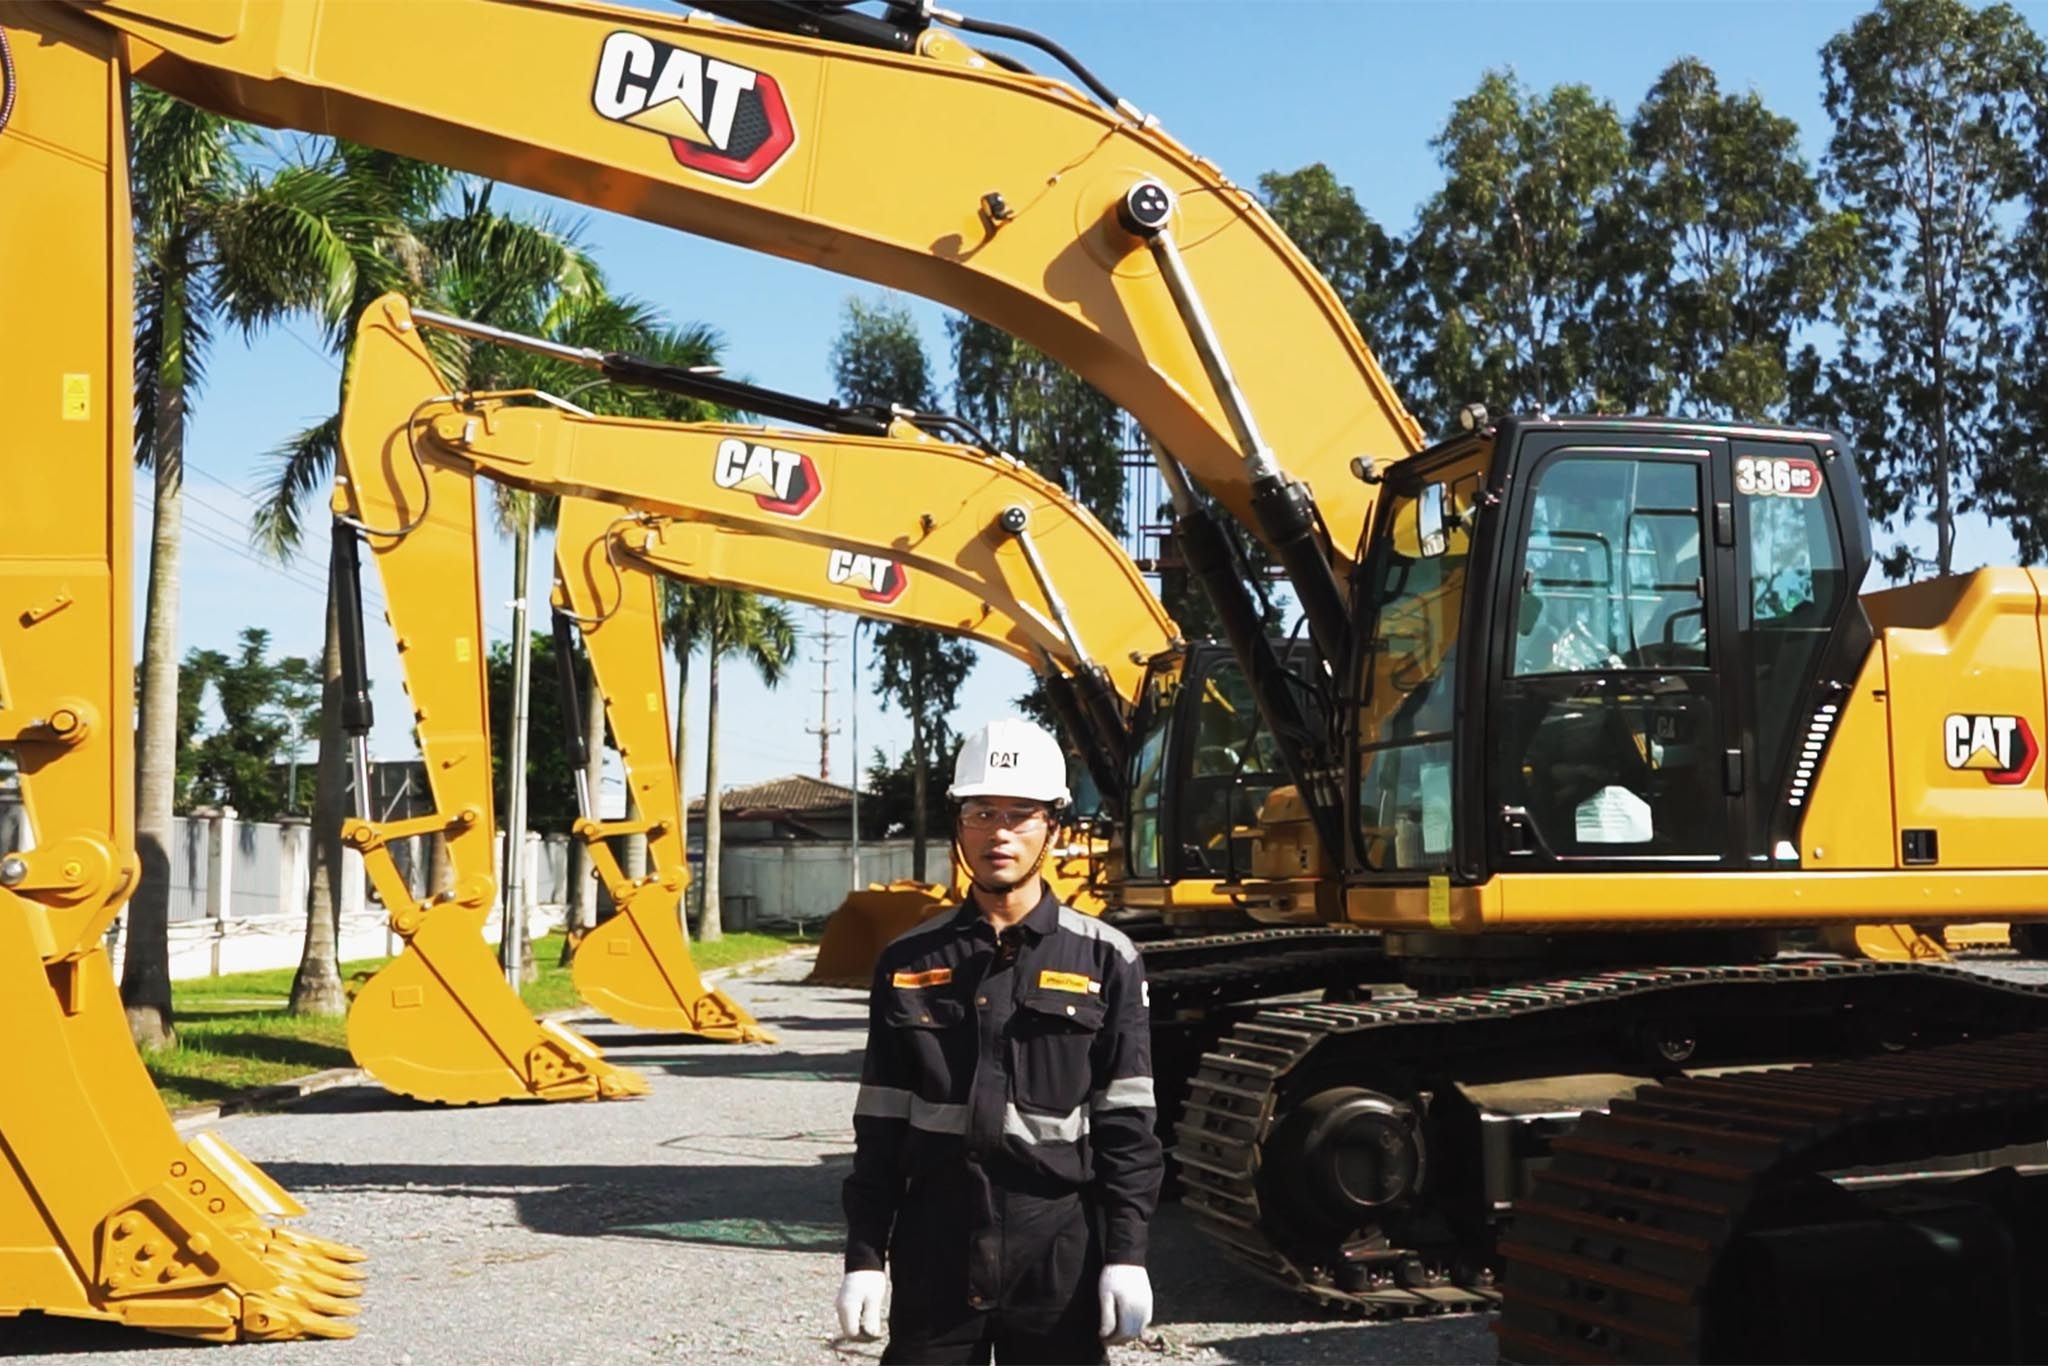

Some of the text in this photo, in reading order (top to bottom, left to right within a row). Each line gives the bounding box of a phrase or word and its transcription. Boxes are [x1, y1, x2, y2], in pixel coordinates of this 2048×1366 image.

[594, 31, 758, 150] CAT
[714, 437, 802, 500] CAT
[1737, 458, 1790, 492] 336
[829, 548, 893, 592] CAT
[990, 751, 1020, 768] CAT
[1945, 714, 2017, 769] CAT
